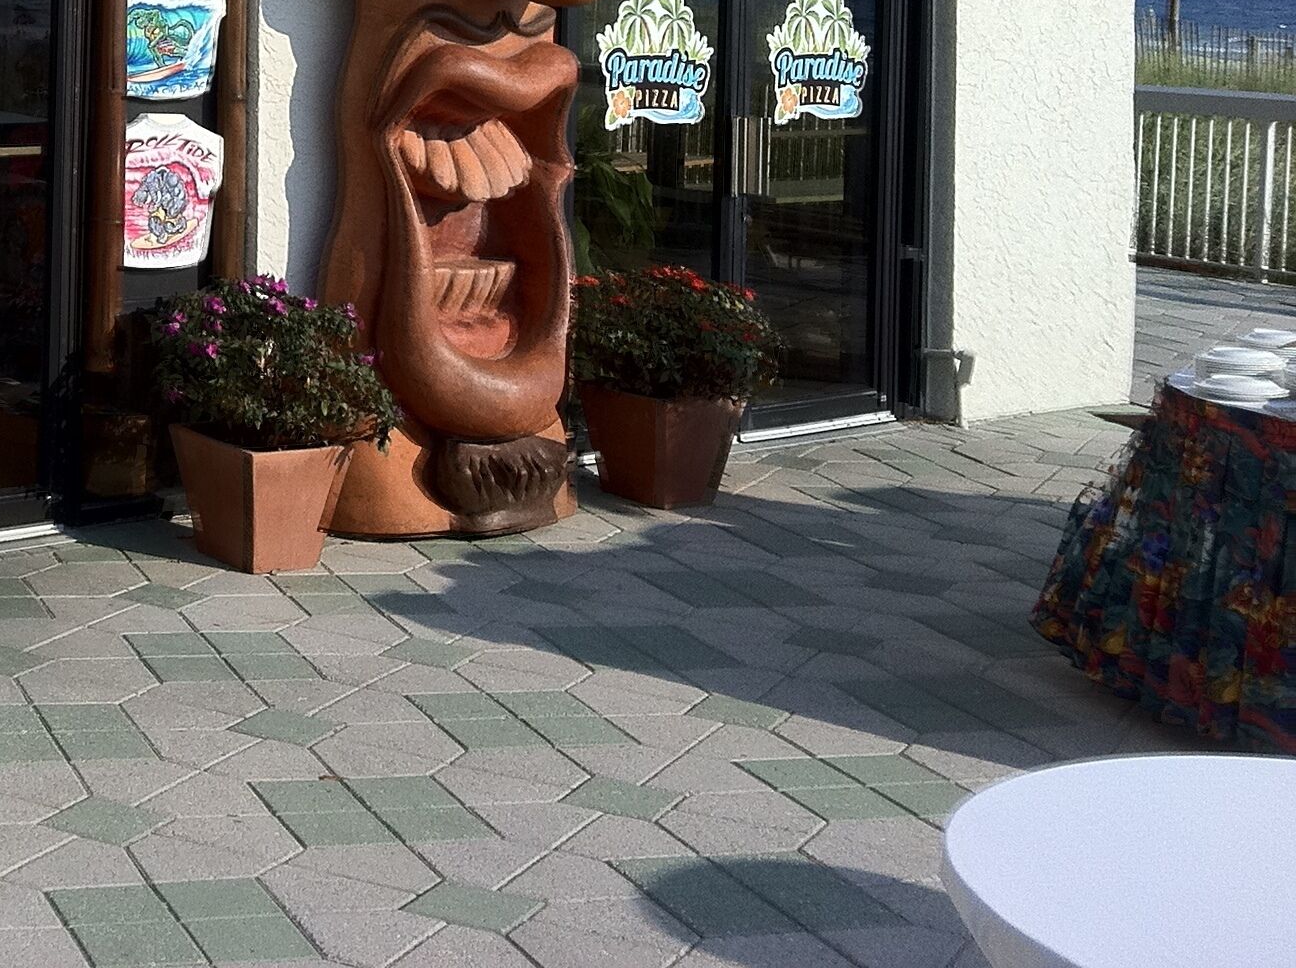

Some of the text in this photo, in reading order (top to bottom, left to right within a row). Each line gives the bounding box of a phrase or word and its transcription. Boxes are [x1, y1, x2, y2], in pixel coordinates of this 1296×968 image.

[608, 52, 705, 90] Paradise
[776, 51, 864, 86] Paradise
[635, 89, 678, 108] PIZZA
[800, 85, 840, 105] PIZZA
